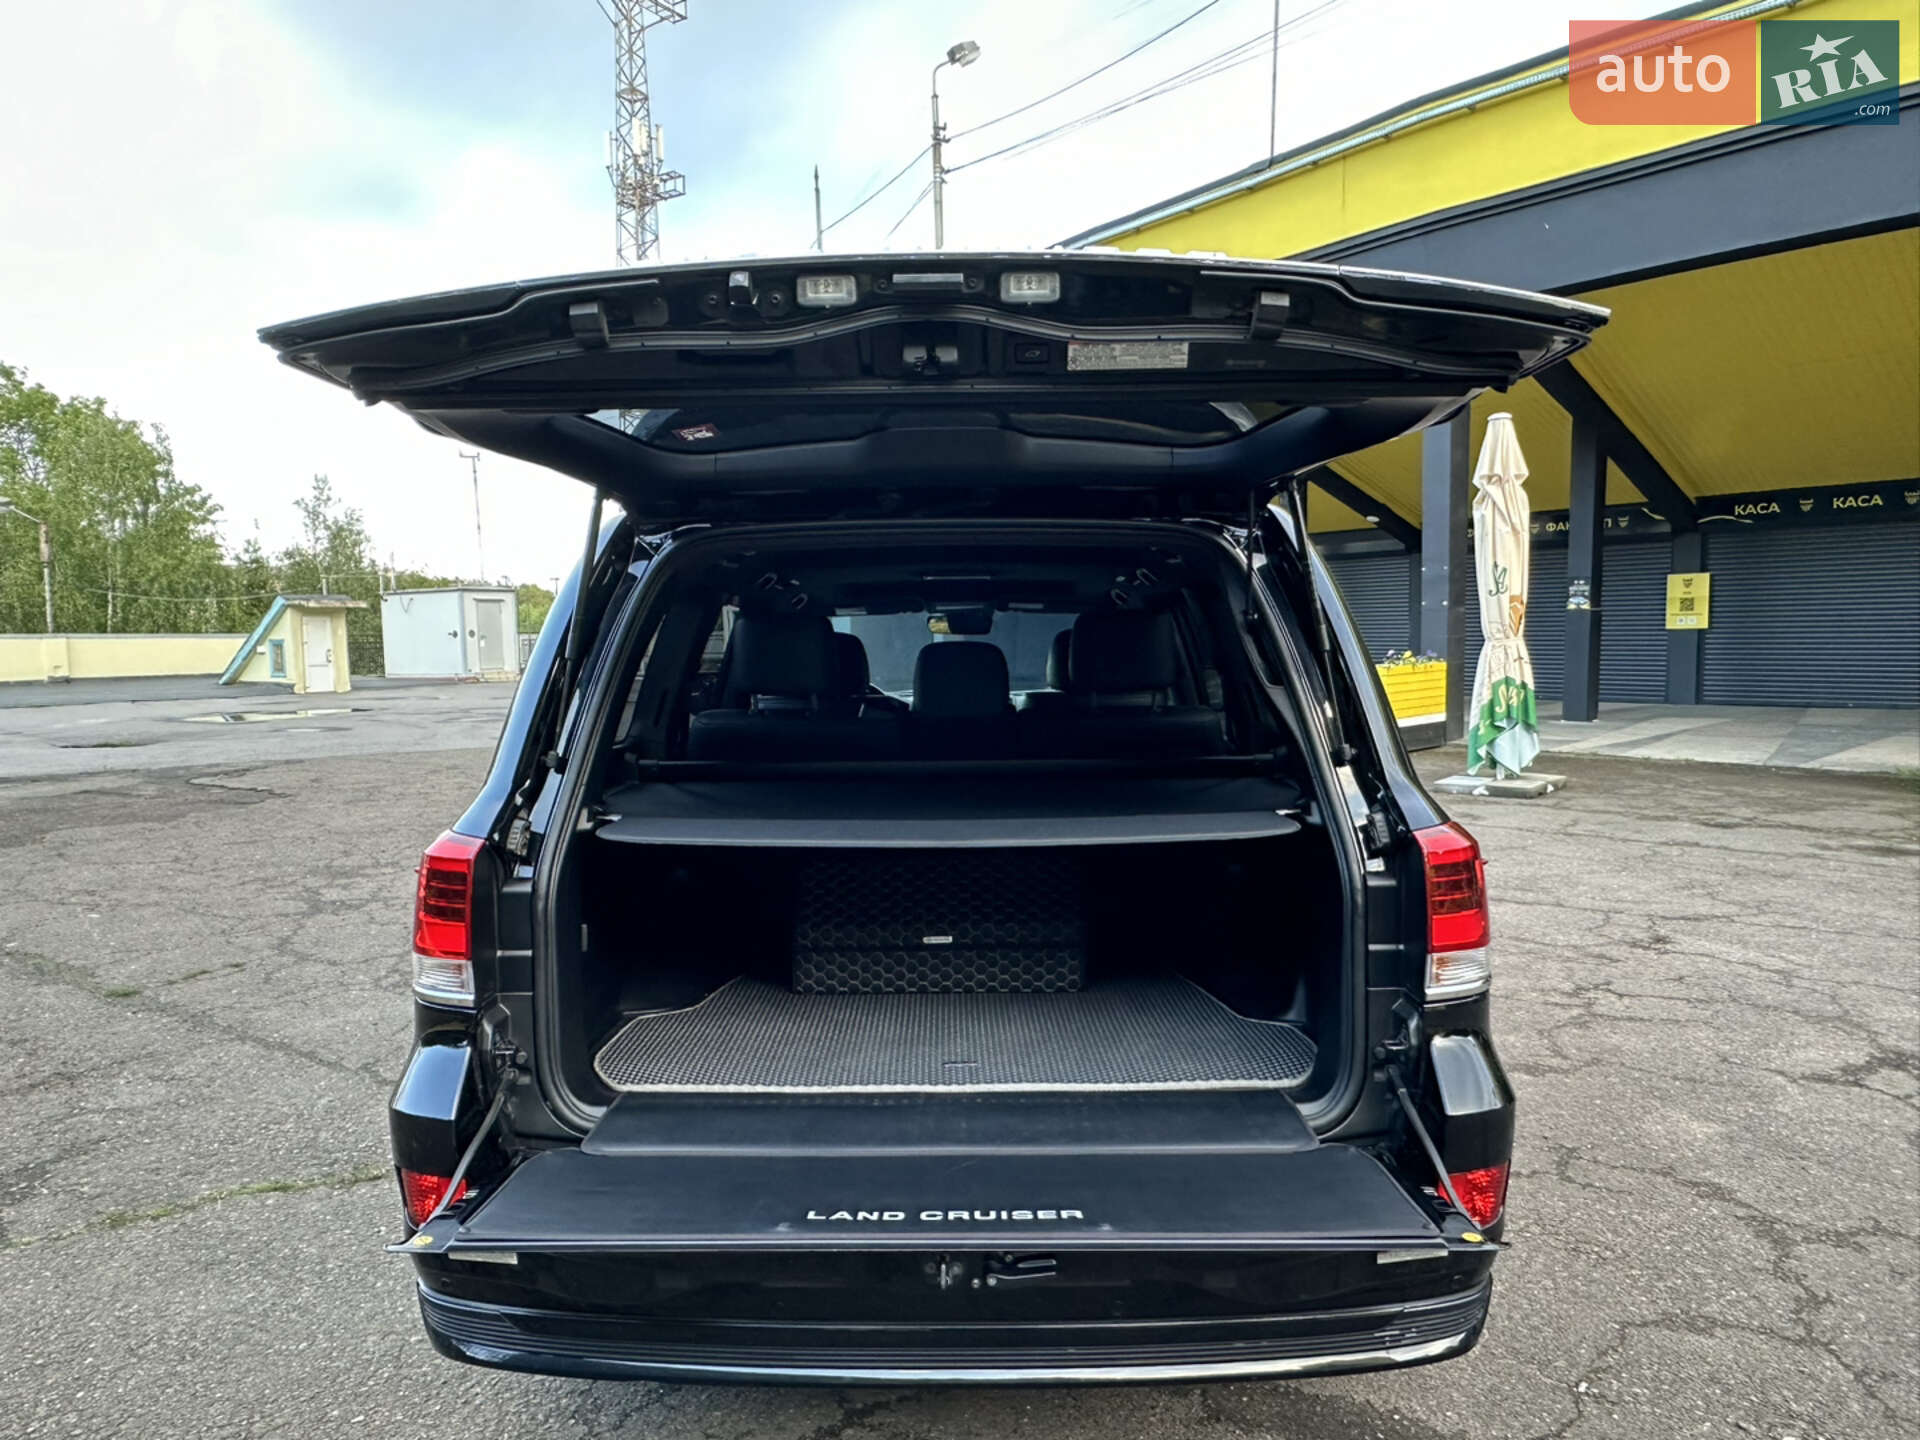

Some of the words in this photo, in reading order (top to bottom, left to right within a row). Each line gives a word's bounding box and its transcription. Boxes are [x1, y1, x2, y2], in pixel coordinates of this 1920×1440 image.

[1734, 502, 1781, 516] КАСА
[1832, 494, 1884, 509] КАСА
[806, 1210, 906, 1221] LAND
[919, 1210, 1085, 1220] CRUISER
